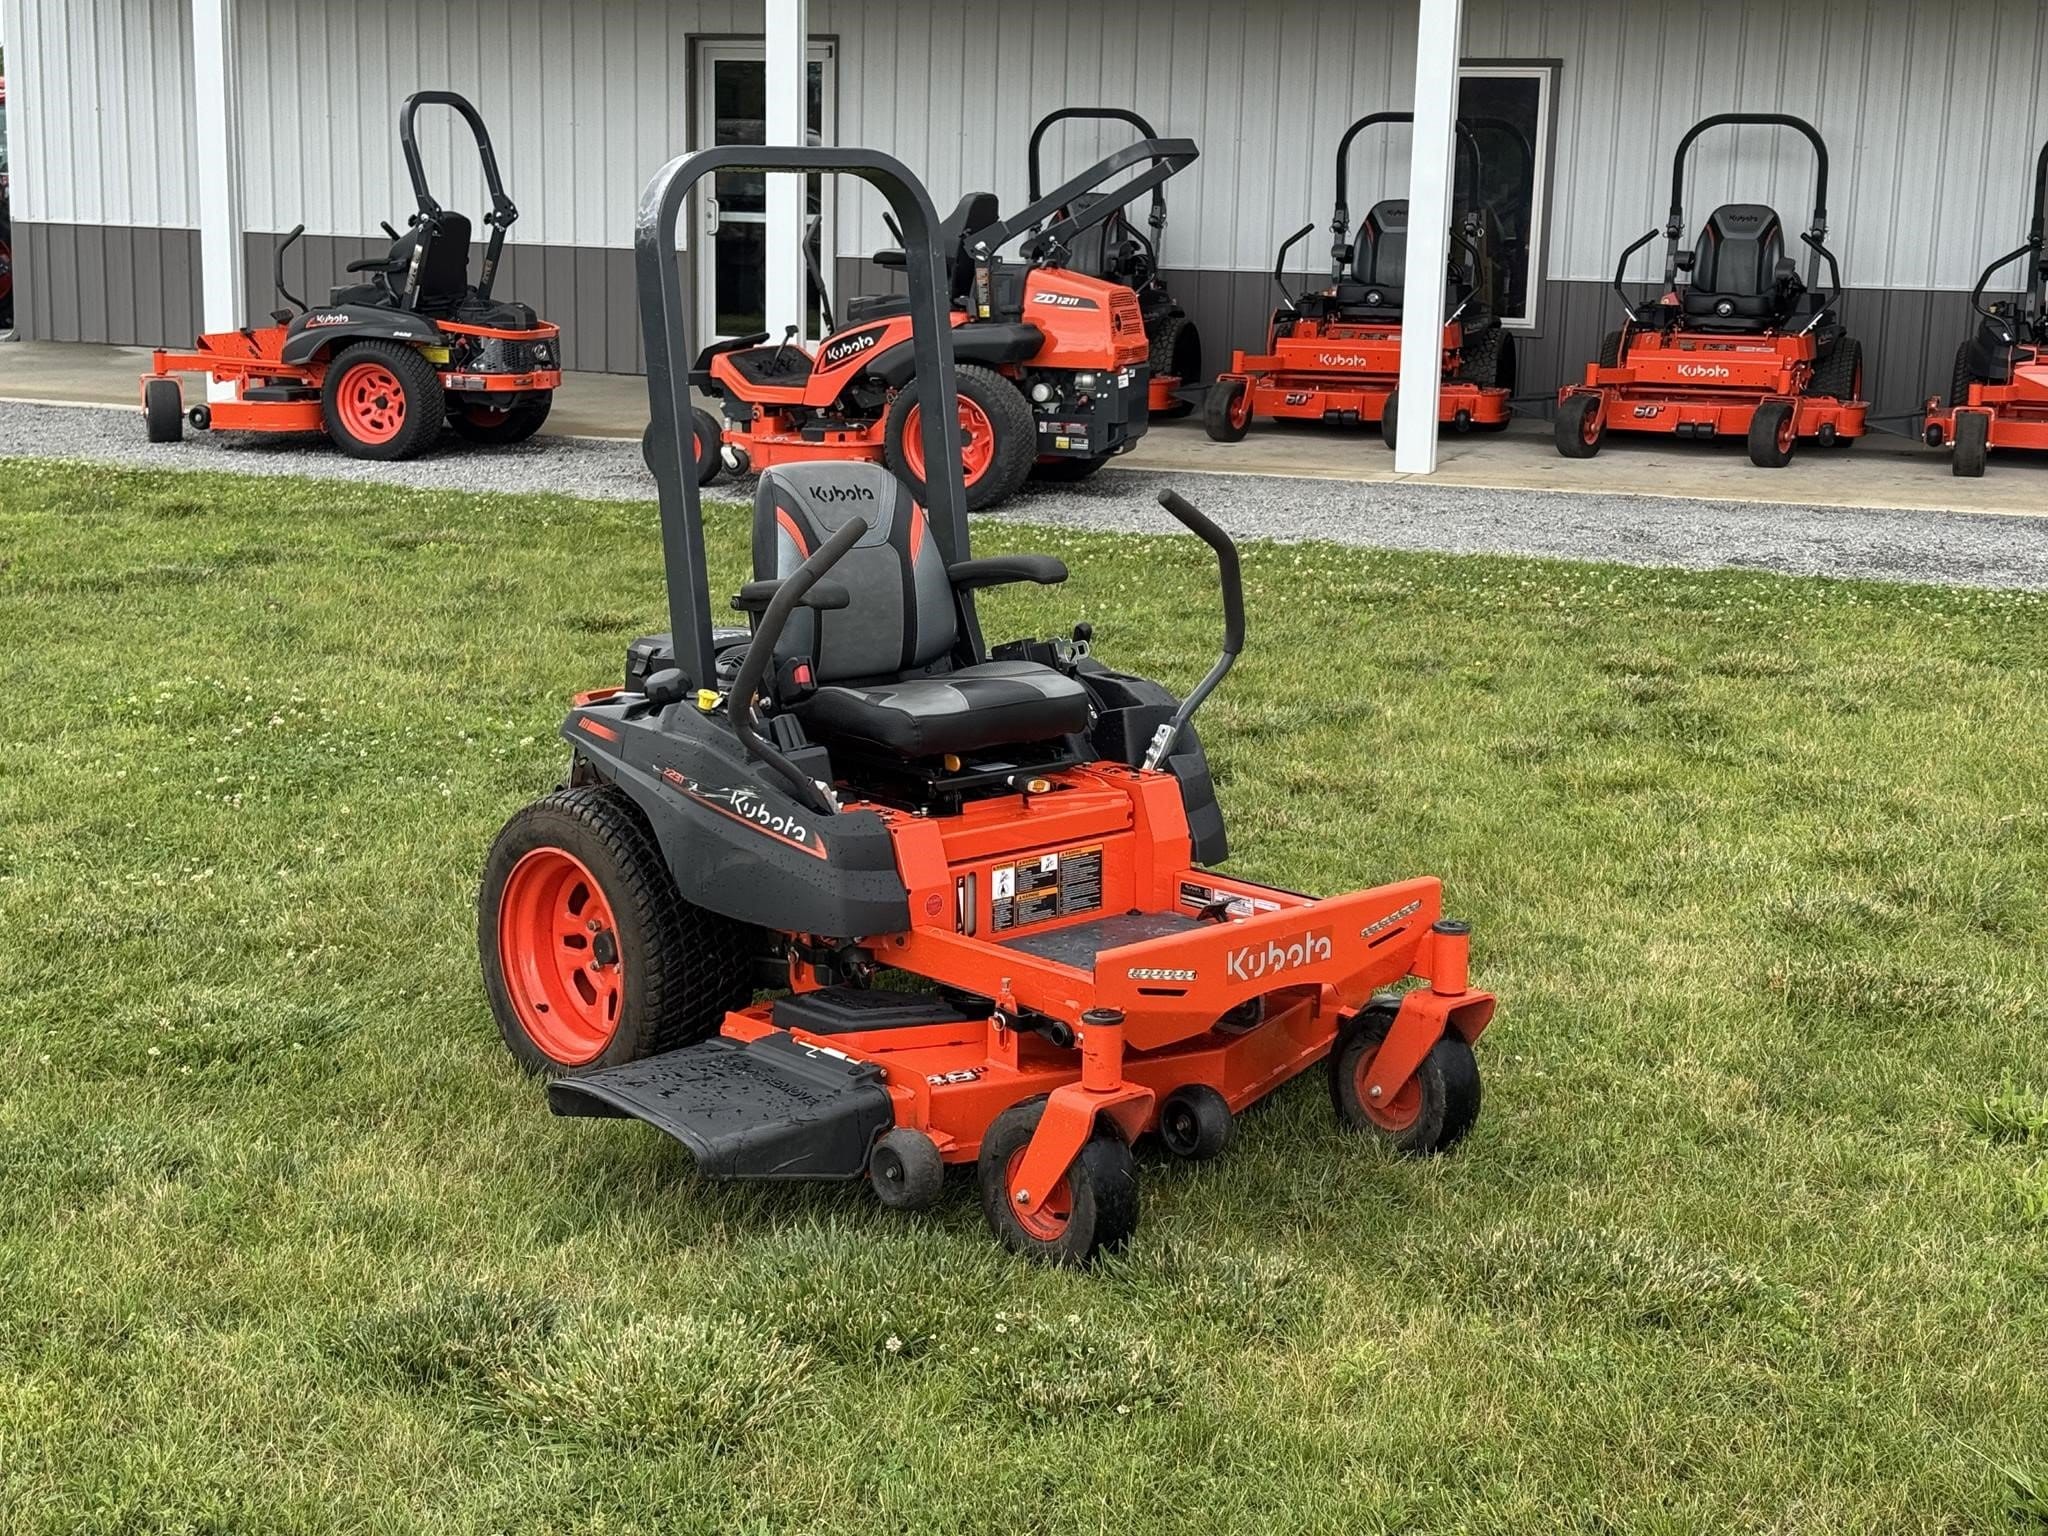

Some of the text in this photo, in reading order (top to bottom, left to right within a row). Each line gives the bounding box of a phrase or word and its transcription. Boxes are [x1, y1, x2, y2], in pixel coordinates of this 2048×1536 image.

[1032, 293, 1079, 305] ZD1211
[827, 336, 875, 360] Kubota
[1320, 353, 1366, 367] Kubota
[1678, 364, 1730, 378] Kubota
[809, 484, 875, 504] Kubota
[730, 791, 807, 843] Kubota
[1227, 931, 1331, 981] Kubota
